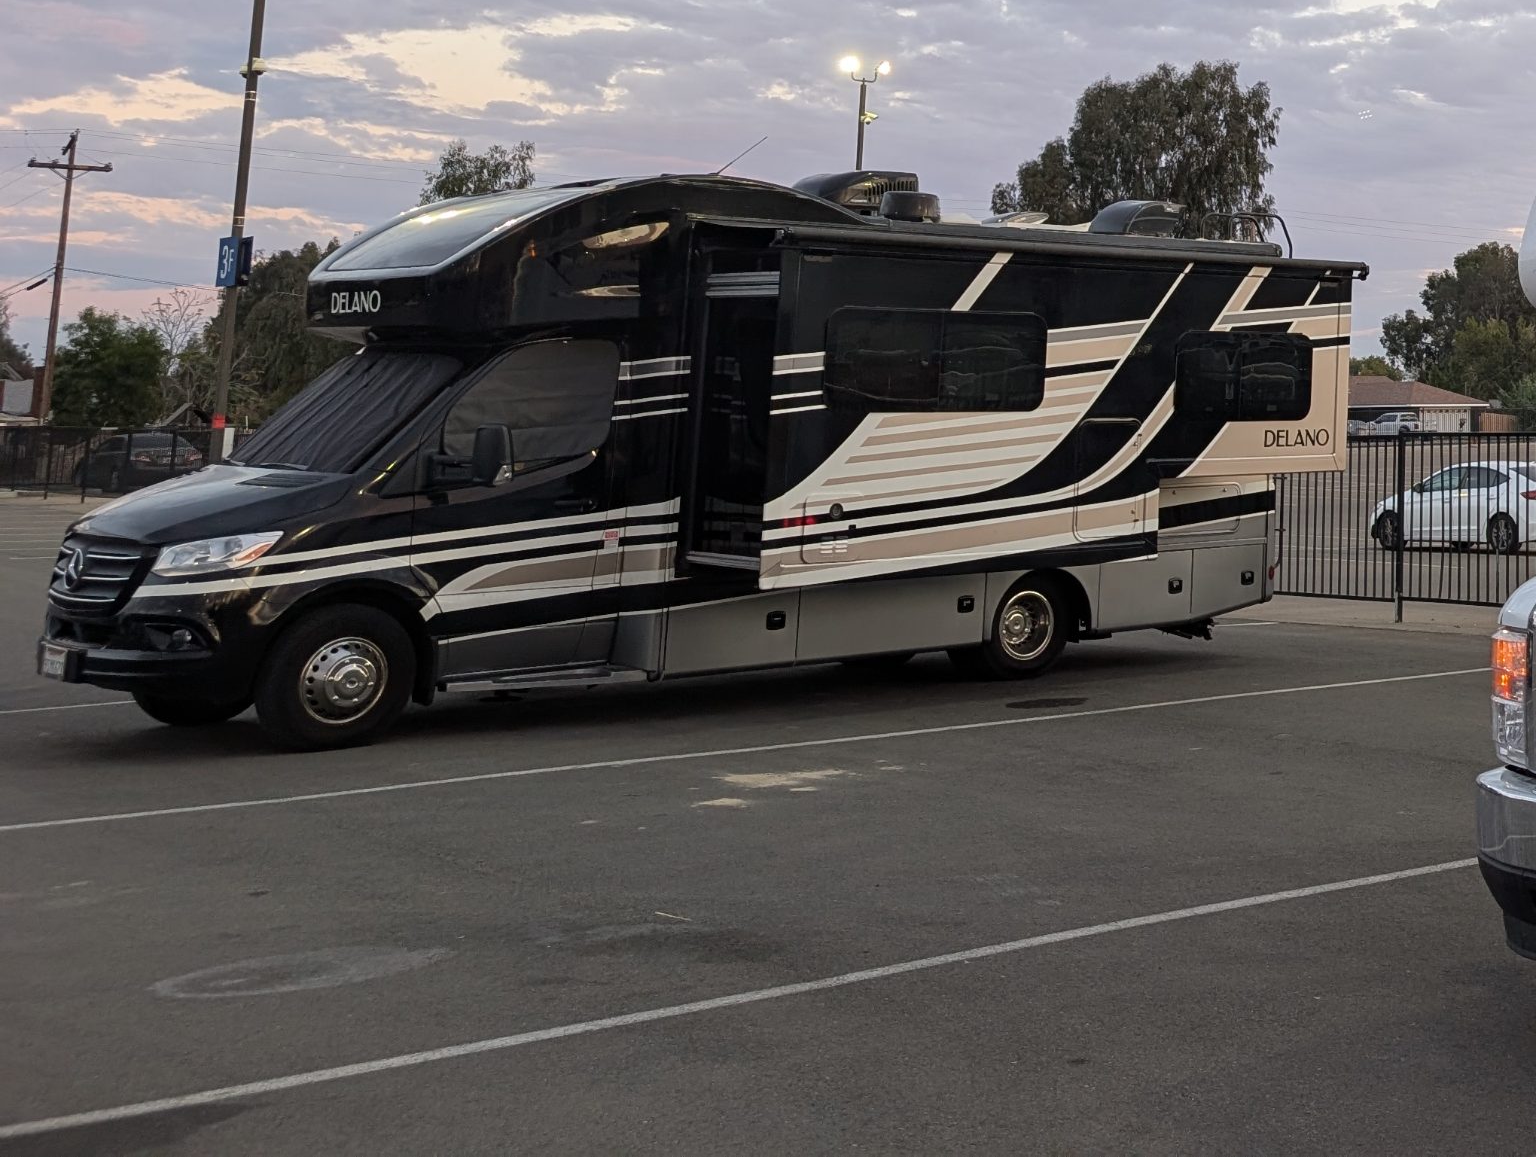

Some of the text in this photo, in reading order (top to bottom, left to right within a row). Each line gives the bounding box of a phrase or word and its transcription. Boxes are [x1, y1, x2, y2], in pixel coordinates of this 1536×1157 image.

[220, 245, 235, 279] 3F
[331, 290, 381, 314] DELANO
[1263, 428, 1330, 447] DELANO
